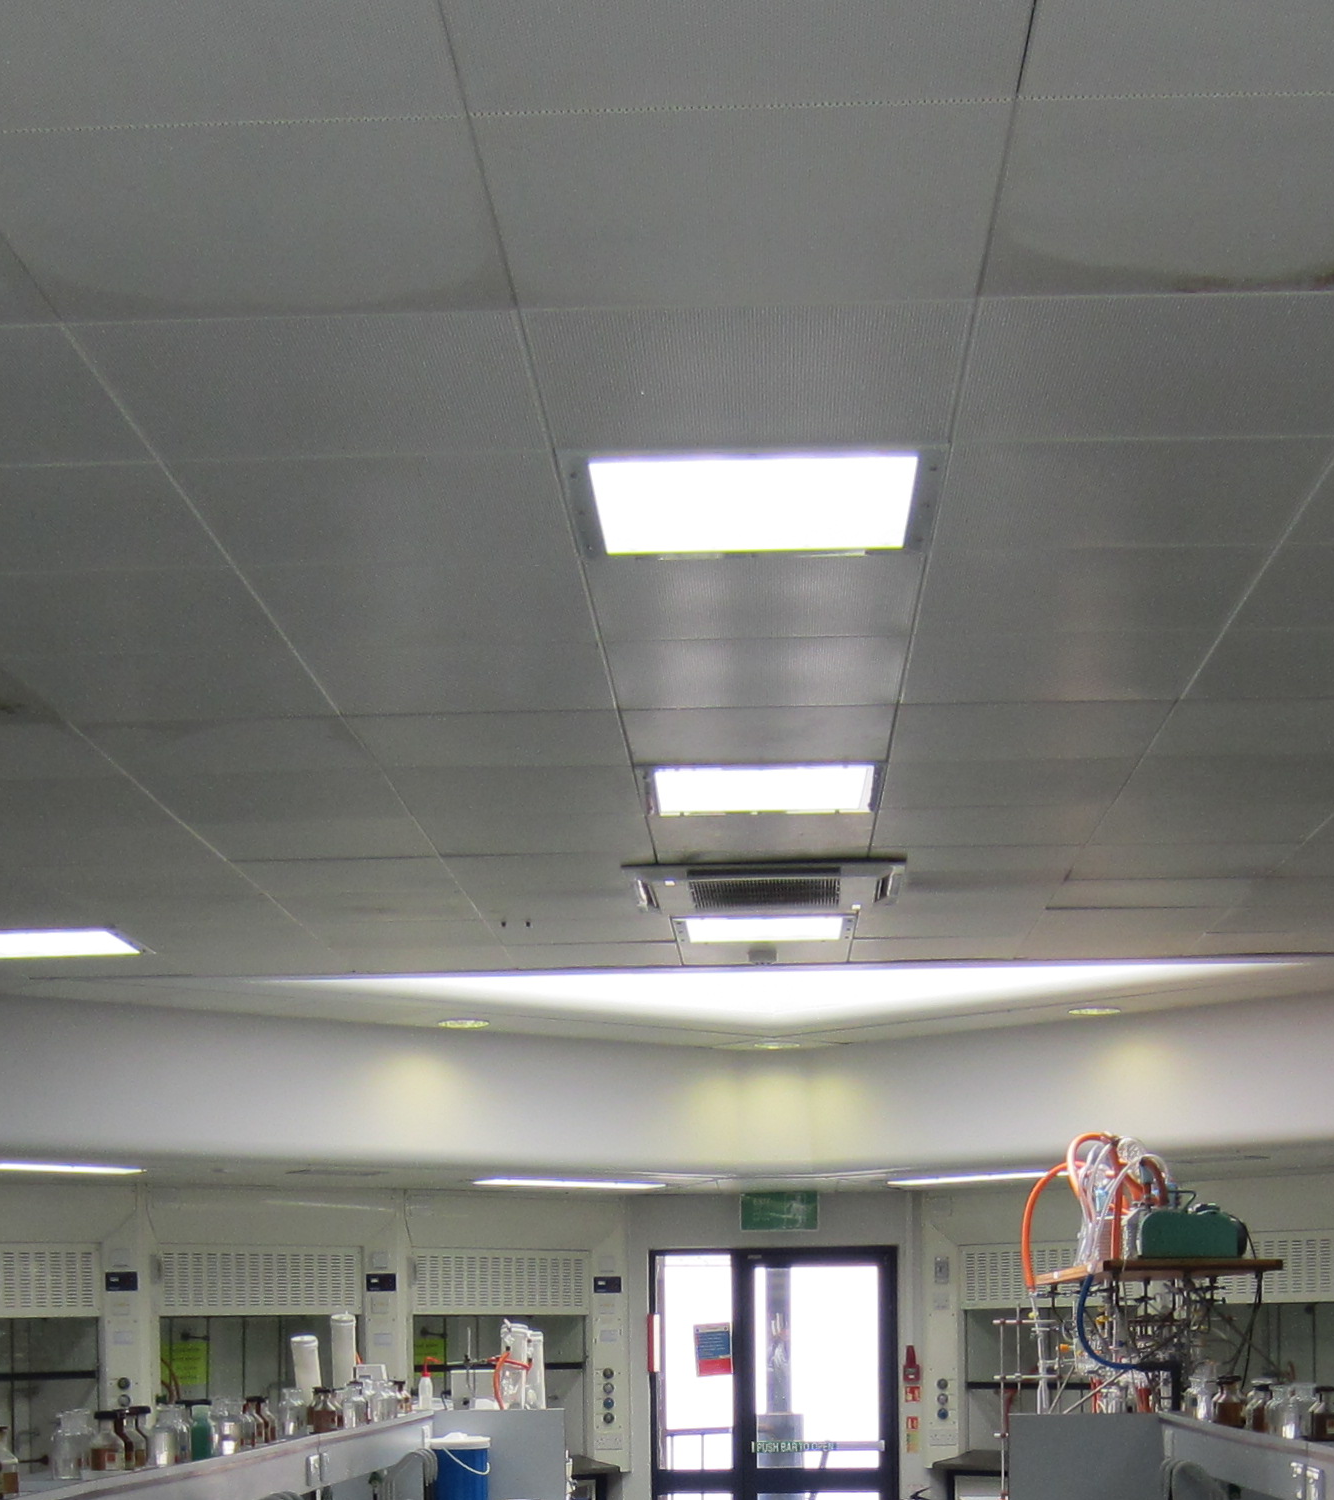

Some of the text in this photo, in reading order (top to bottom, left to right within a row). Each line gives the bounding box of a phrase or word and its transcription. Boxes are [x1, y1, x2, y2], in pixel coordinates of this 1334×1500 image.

[756, 1440, 834, 1453] PUSH BAR TO OPEN
